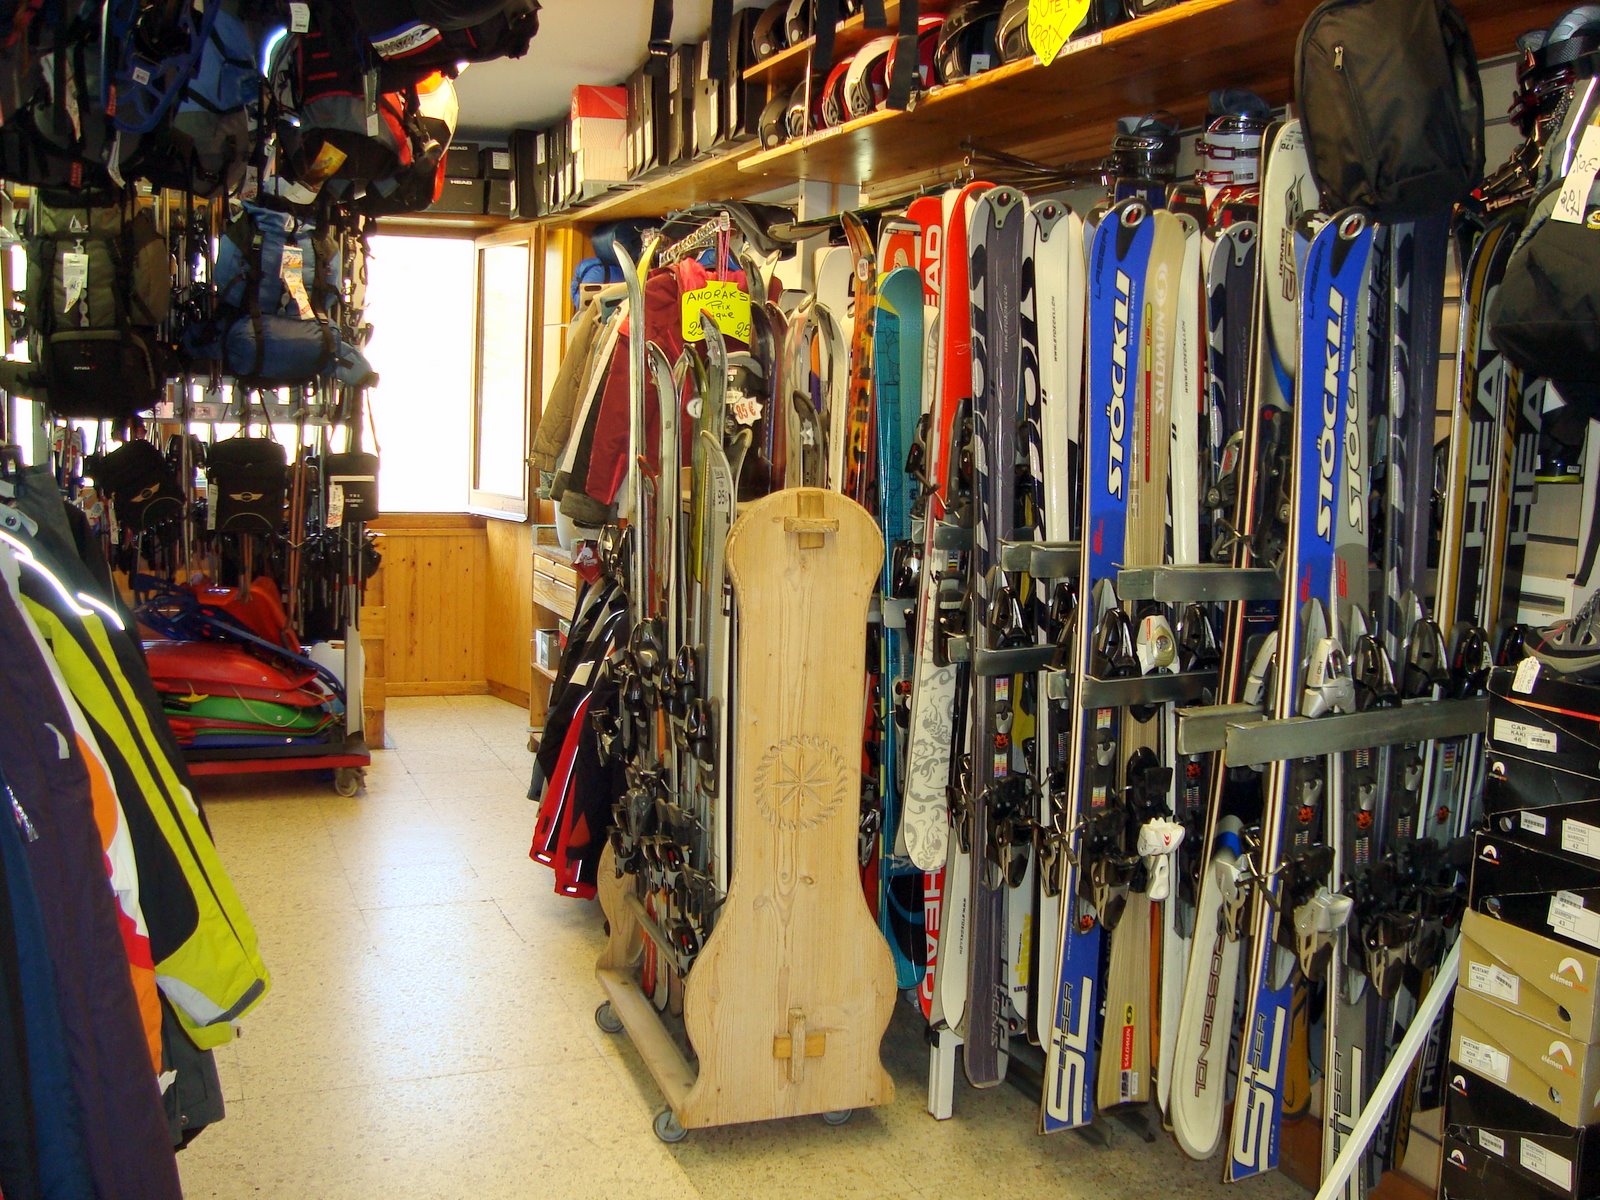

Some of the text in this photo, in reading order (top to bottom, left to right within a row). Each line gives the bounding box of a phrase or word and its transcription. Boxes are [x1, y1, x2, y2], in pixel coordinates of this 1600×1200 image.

[687, 289, 749, 304] ANORAKS
[706, 300, 731, 310] Prix
[925, 224, 942, 307] EAD
[1095, 227, 1110, 300] LASER
[1308, 240, 1327, 321] LASER
[1106, 268, 1132, 500] STÖCKLI
[1155, 309, 1167, 418] SALOMON
[735, 403, 748, 421] 85
[1316, 284, 1345, 544] STÖCKLI
[1510, 377, 1545, 547] HEA
[1511, 724, 1527, 732] CAP
[1047, 976, 1093, 1127] SL
[1058, 981, 1074, 1071] LASER
[1121, 1027, 1131, 1069] SALOMON
[1247, 1012, 1266, 1110] LASER
[1421, 1012, 1442, 1094] HEA
[1233, 1005, 1286, 1172] SL
